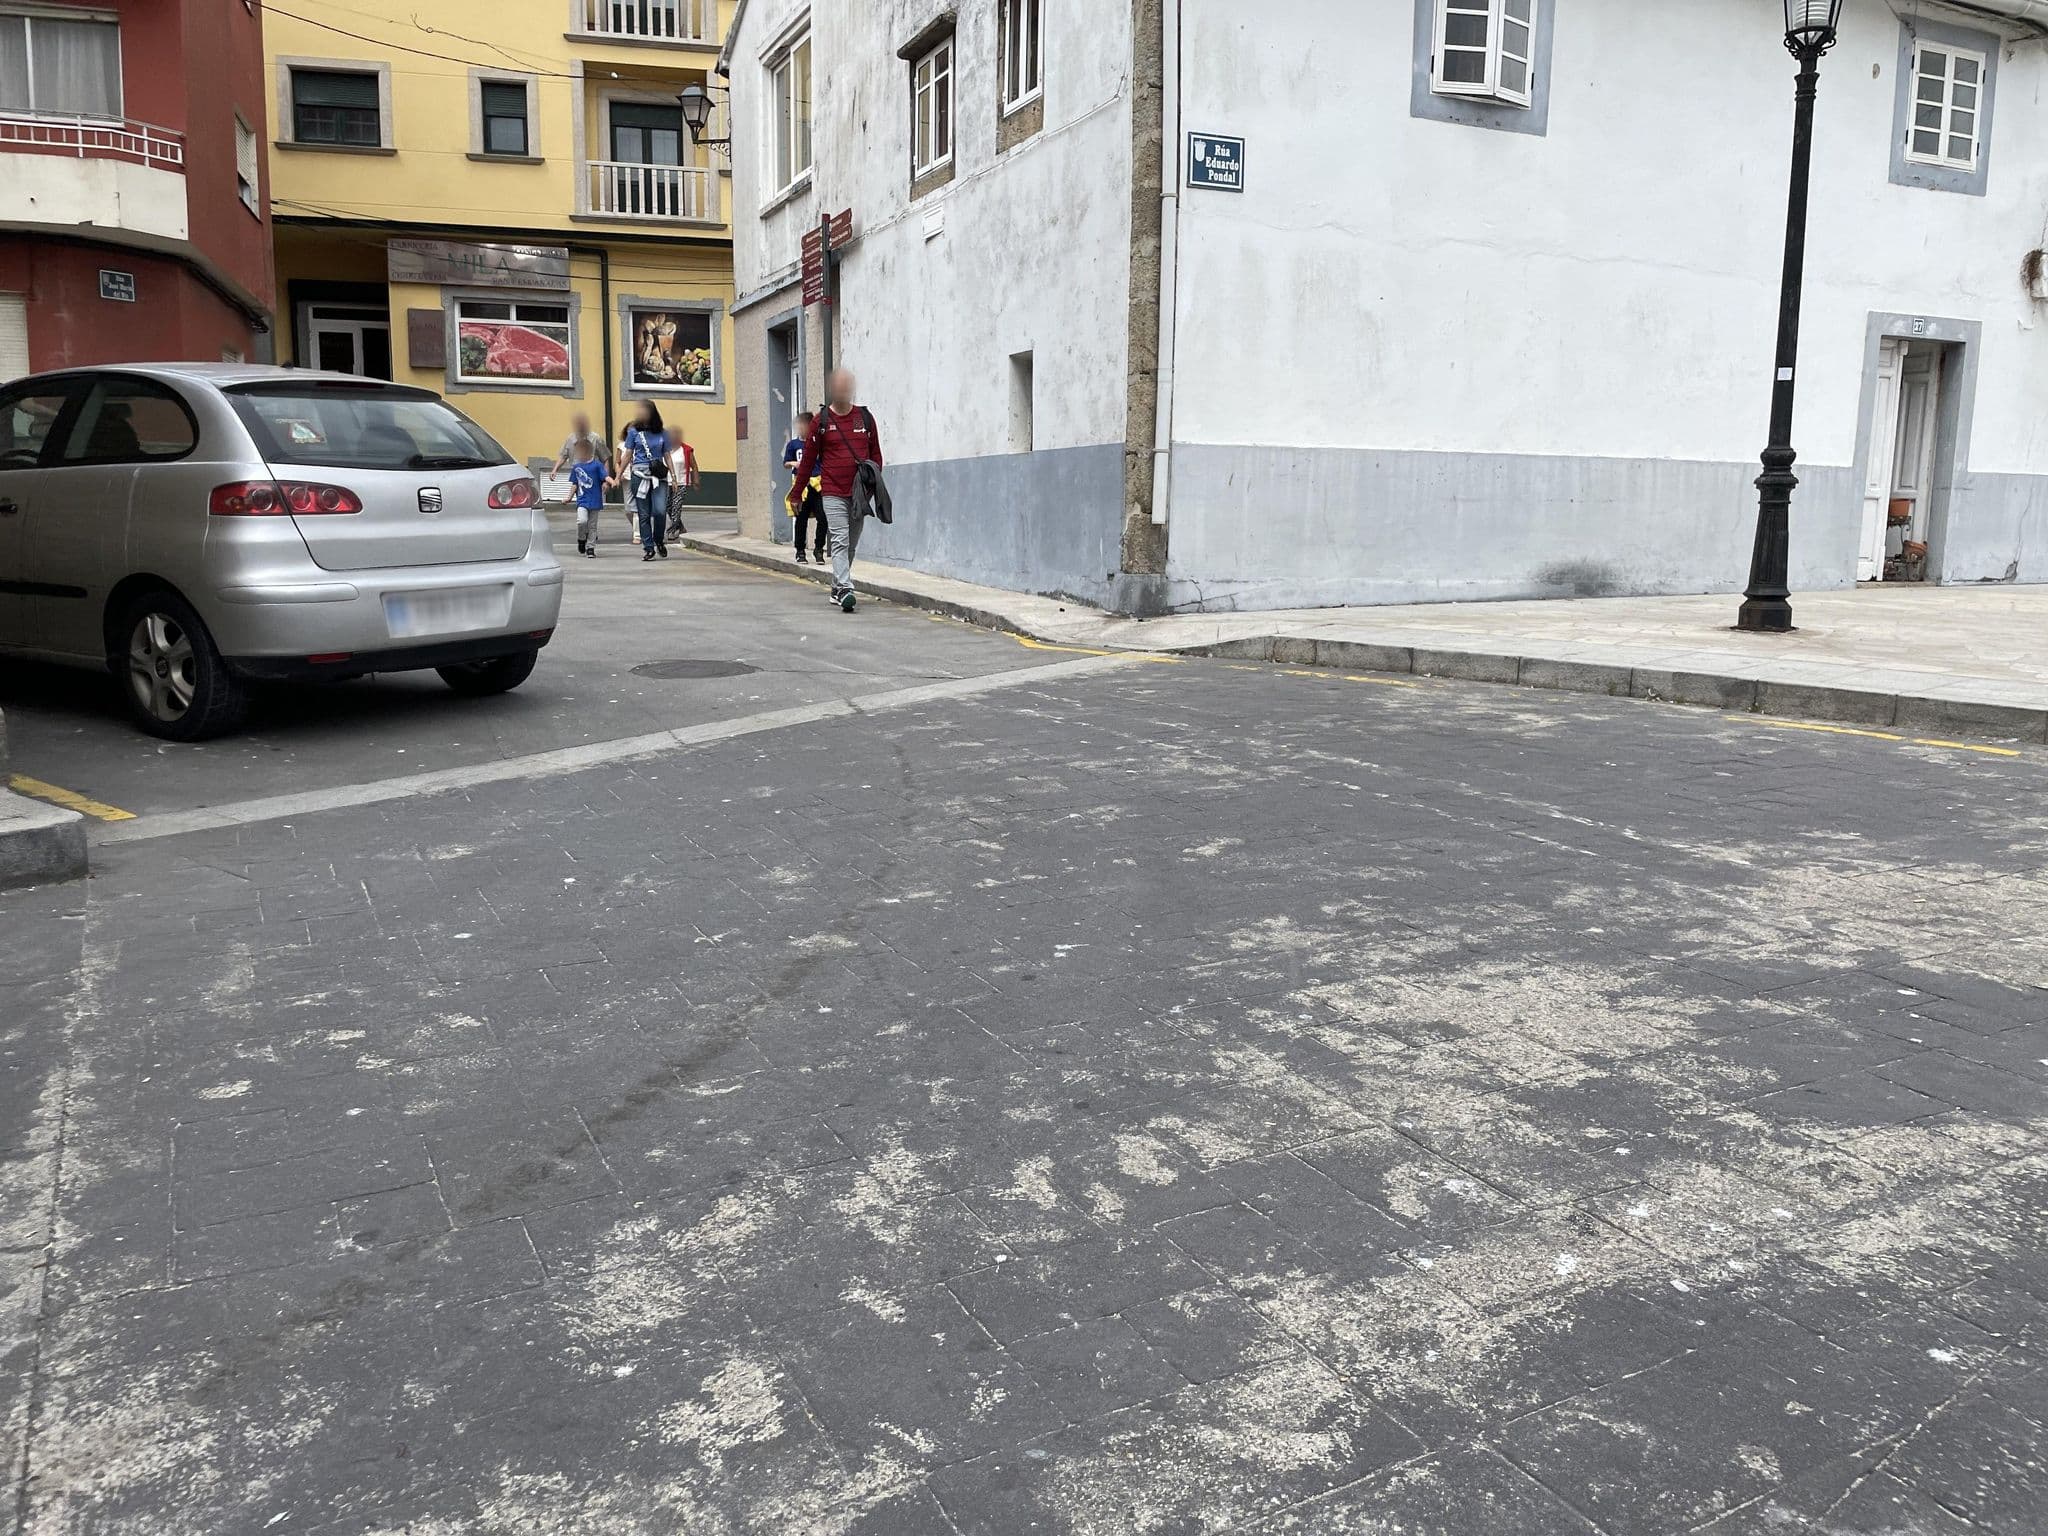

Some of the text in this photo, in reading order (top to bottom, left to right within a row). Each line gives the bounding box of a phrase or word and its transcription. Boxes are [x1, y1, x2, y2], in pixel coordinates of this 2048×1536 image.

[1214, 144, 1231, 157] Rúa
[1205, 156, 1239, 171] Eduardo
[1208, 169, 1236, 183] Pondal
